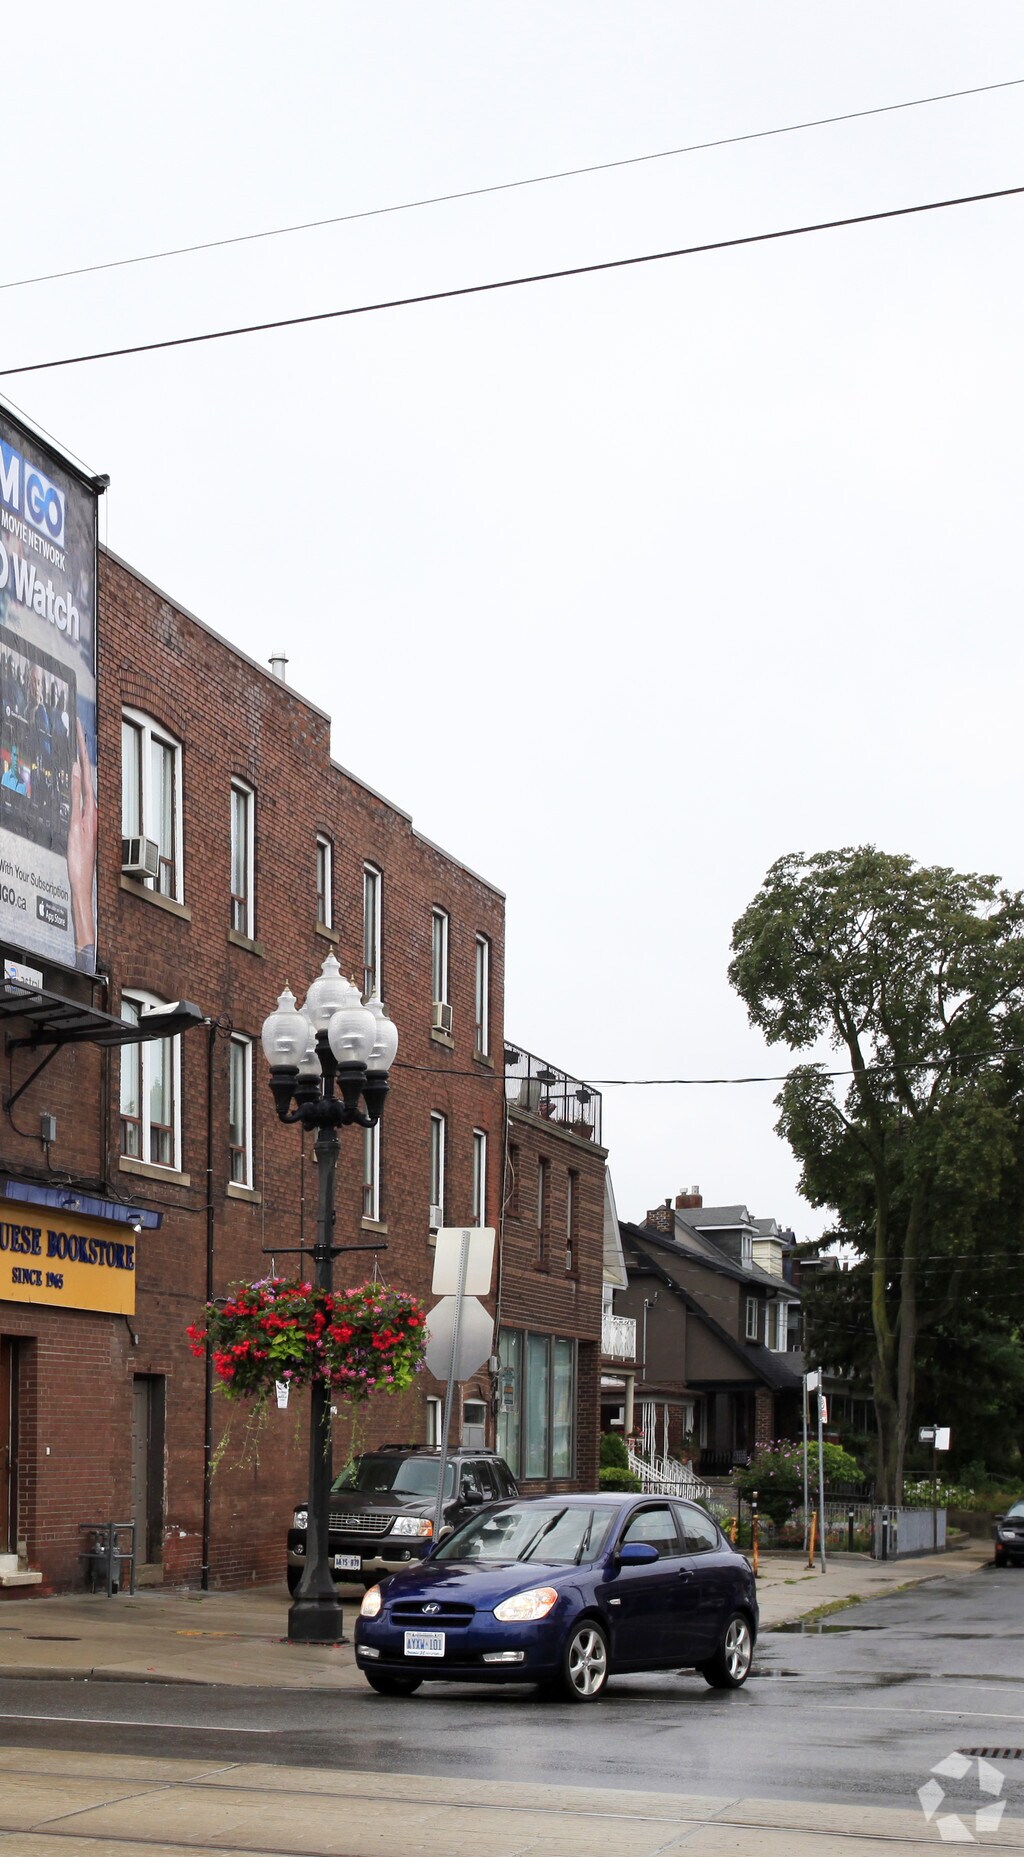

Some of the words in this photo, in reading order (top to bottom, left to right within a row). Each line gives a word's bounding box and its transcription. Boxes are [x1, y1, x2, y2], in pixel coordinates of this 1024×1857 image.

[26, 473, 63, 538] GO
[1, 509, 27, 544] MOVIE
[28, 527, 66, 573] NETWORK
[12, 551, 80, 642] Watch
[15, 864, 30, 883] Your
[30, 872, 69, 901] Subscription
[46, 909, 54, 923] App
[54, 913, 66, 927] Store
[46, 1229, 135, 1271] BOOKSTORE
[11, 1266, 42, 1286] SINCE
[45, 1271, 64, 1290] 1965
